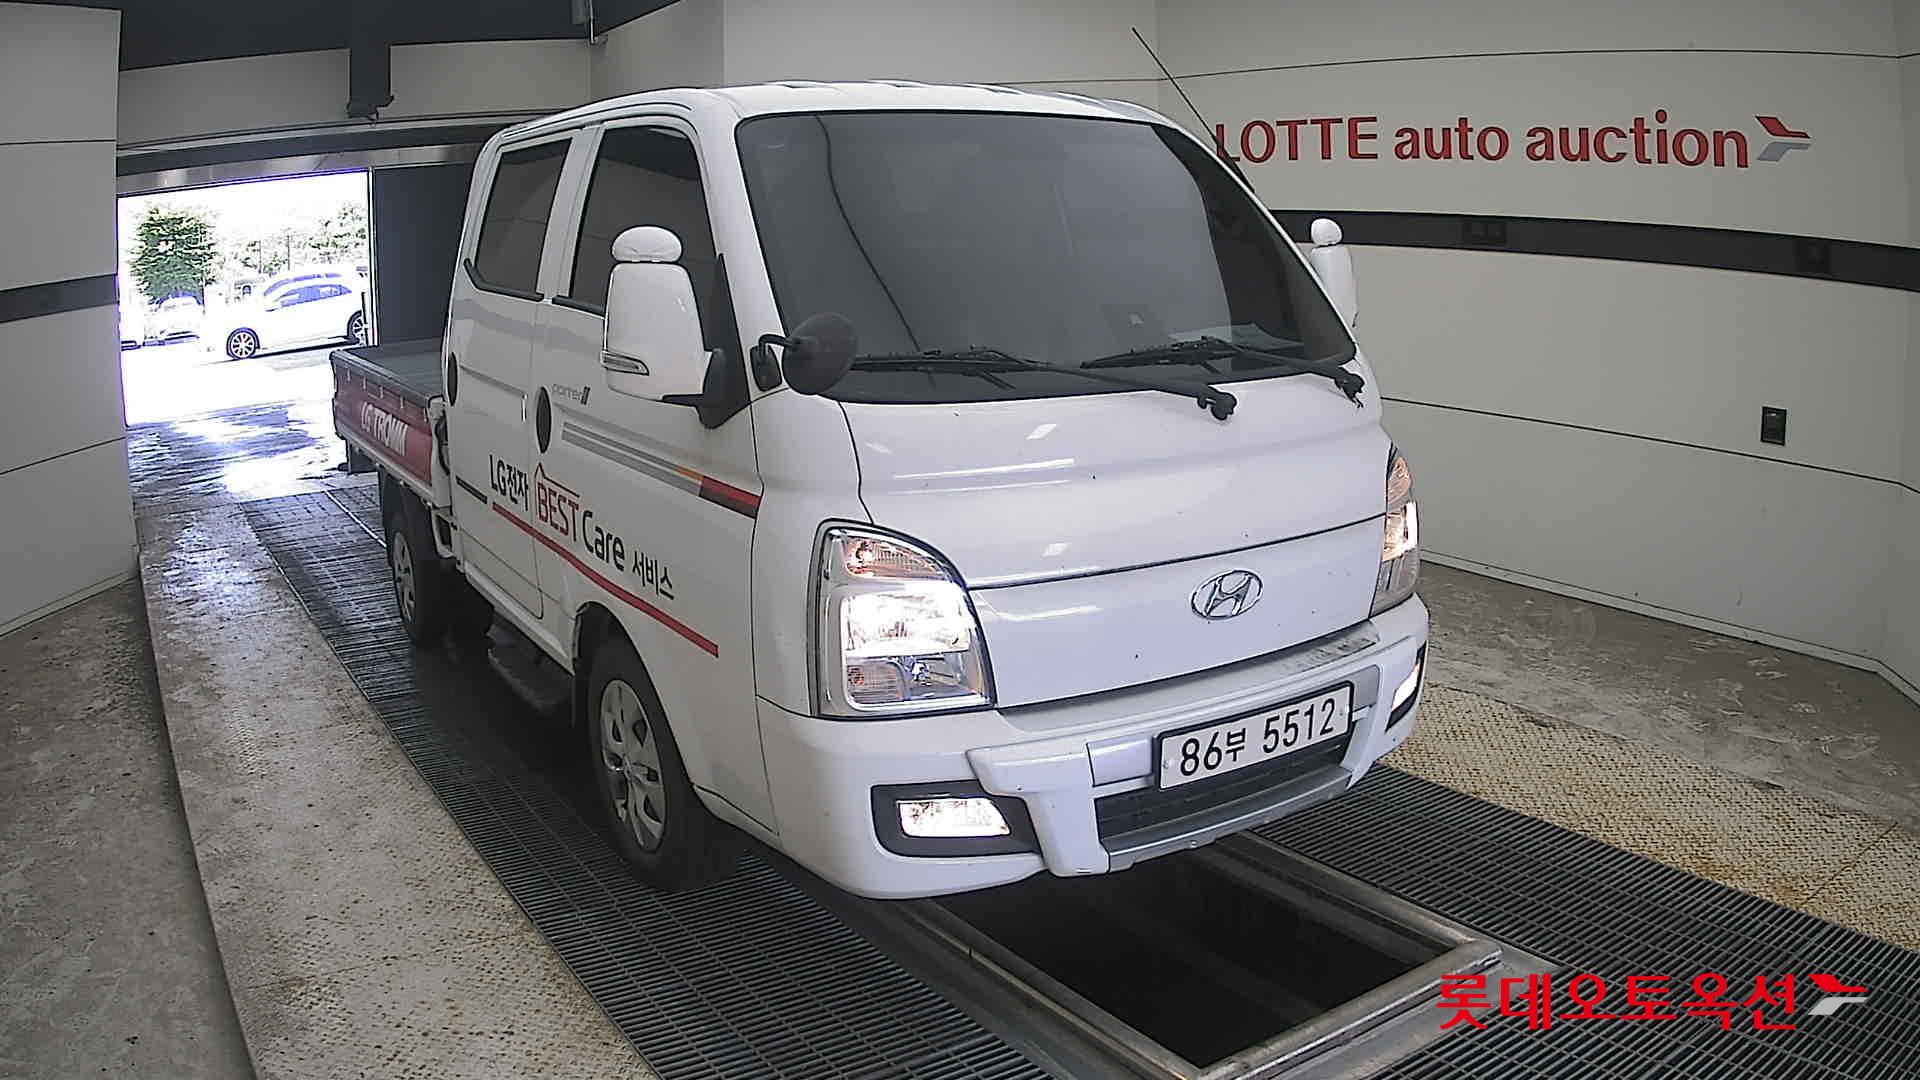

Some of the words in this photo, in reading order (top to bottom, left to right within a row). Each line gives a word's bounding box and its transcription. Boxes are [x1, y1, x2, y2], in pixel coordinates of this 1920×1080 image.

[1214, 116, 1378, 163] LOTTE
[1394, 117, 1509, 161] auto
[1526, 109, 1749, 168] auction
[489, 454, 529, 512] LG전자
[537, 481, 580, 542] BEST
[582, 510, 625, 572] Care
[632, 551, 675, 600] 서비스
[1179, 727, 1247, 777] 86부
[1263, 698, 1335, 754] 5512
